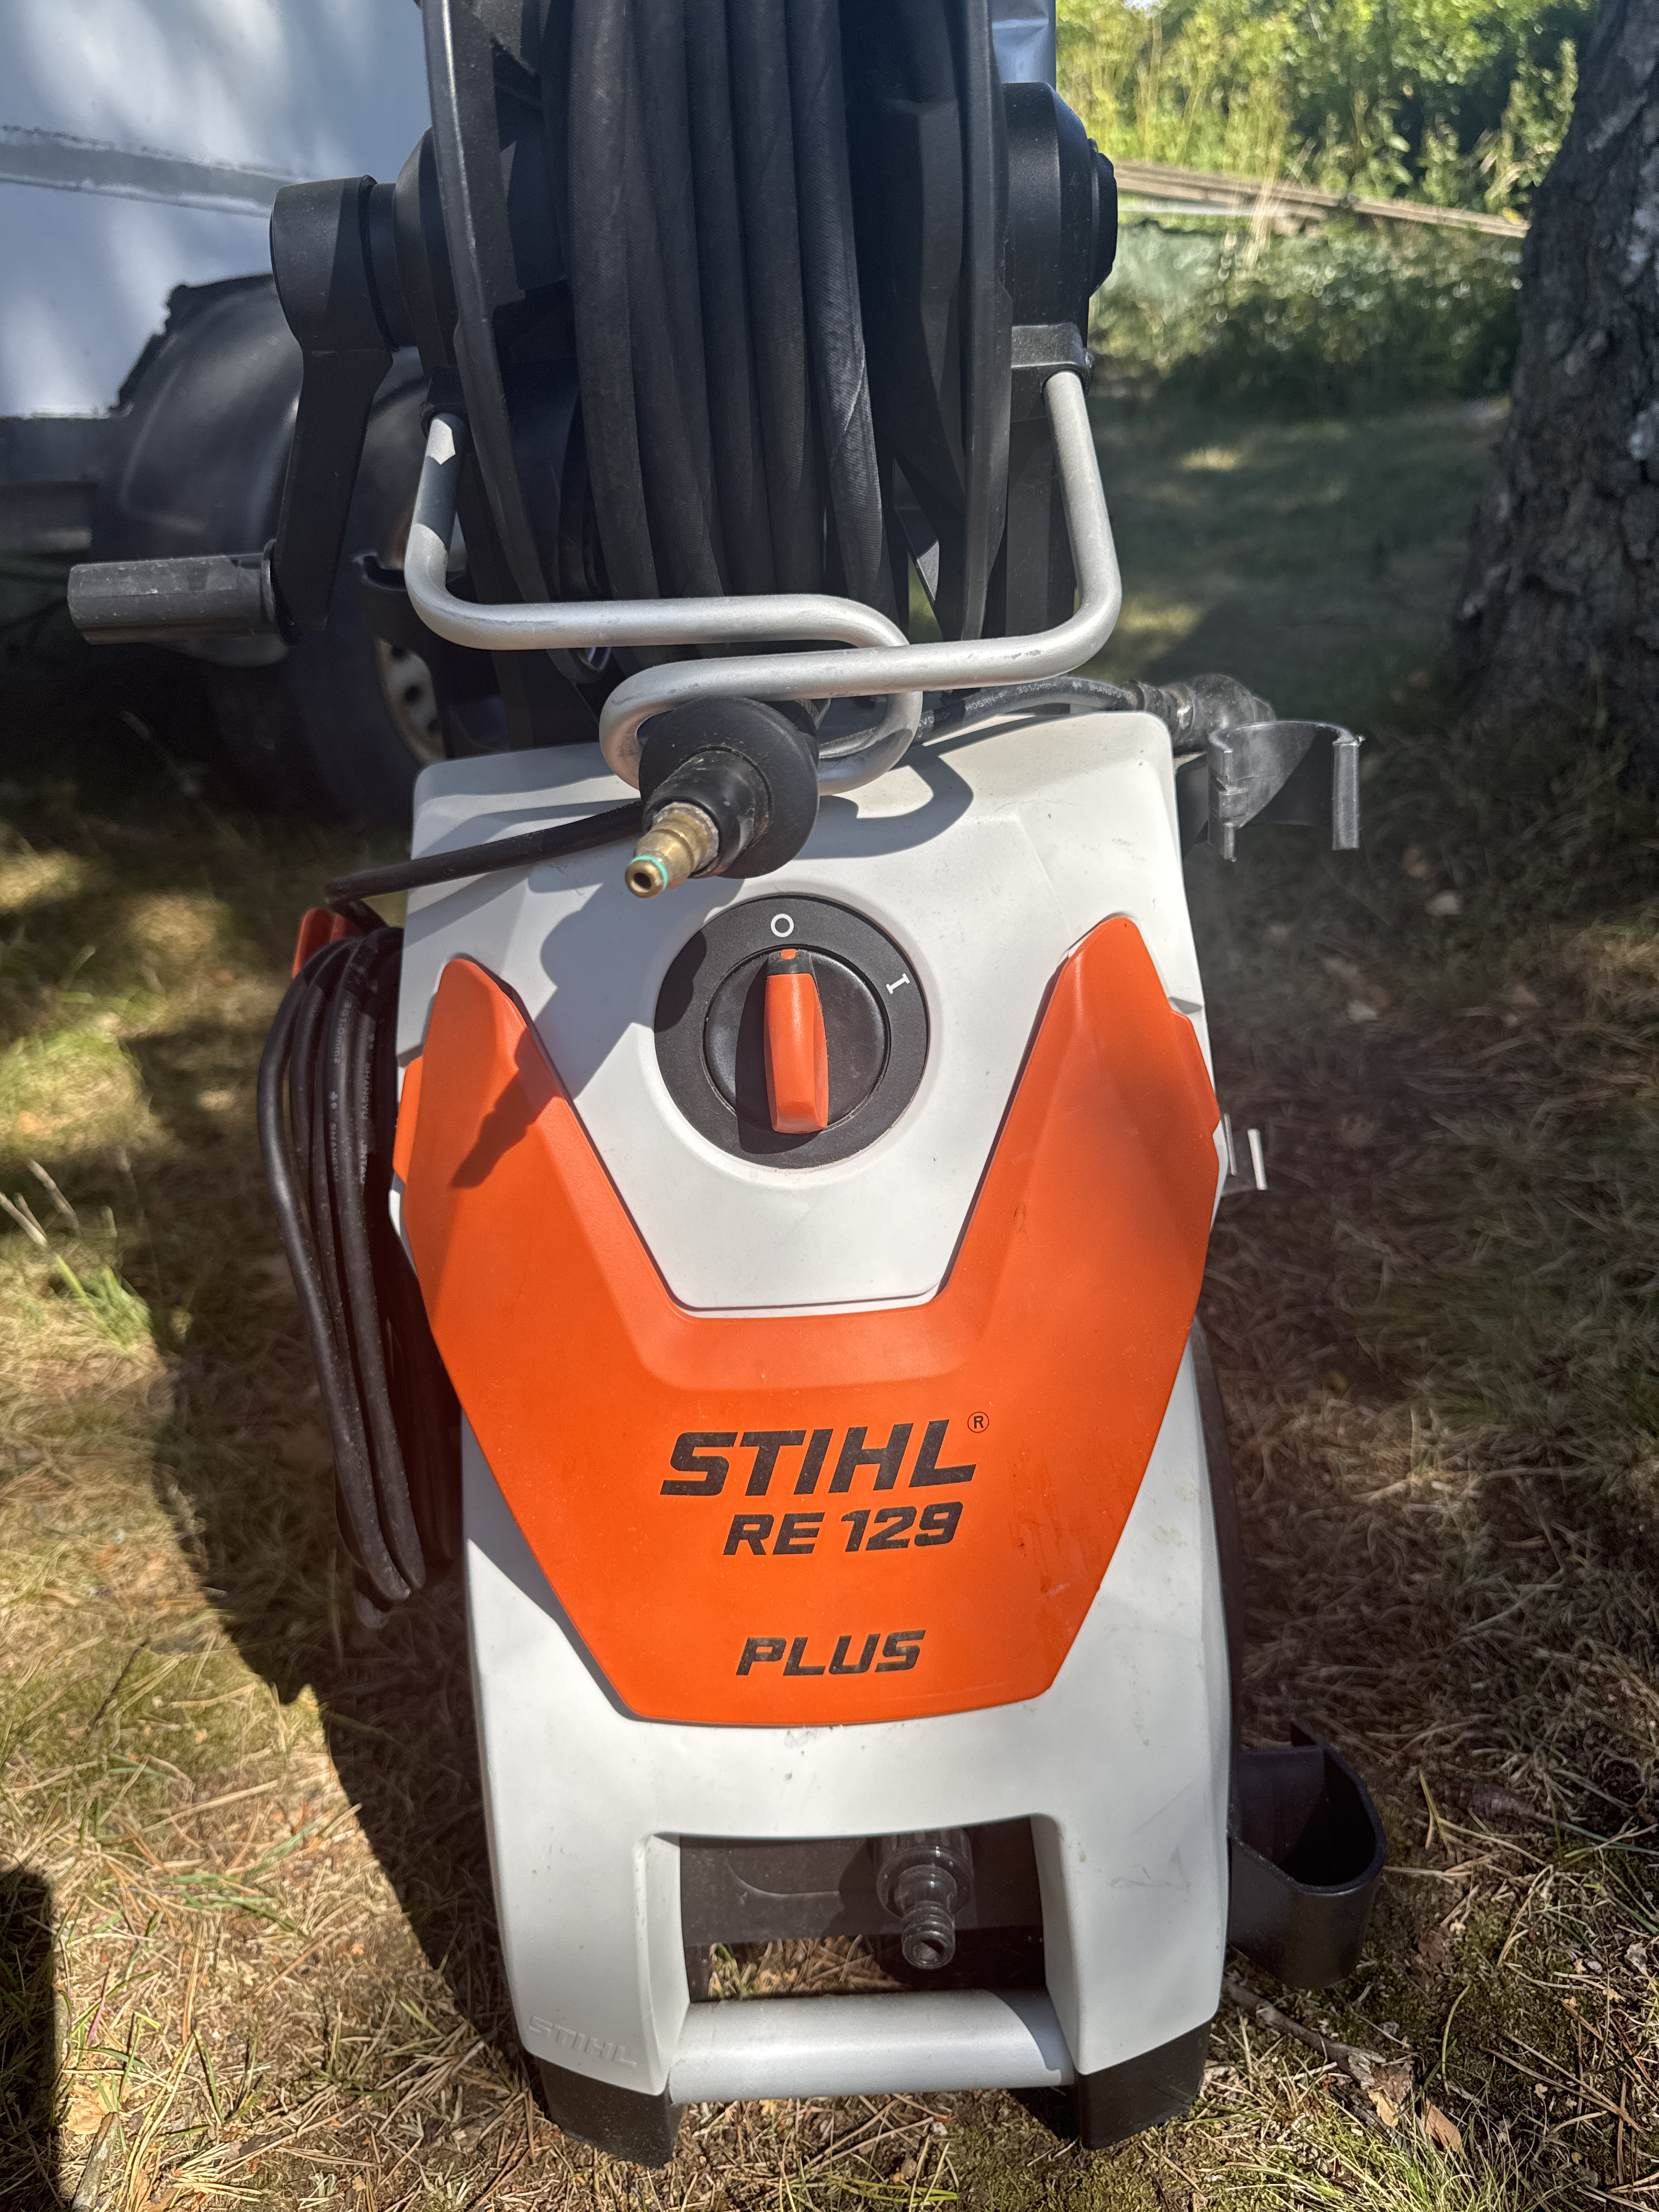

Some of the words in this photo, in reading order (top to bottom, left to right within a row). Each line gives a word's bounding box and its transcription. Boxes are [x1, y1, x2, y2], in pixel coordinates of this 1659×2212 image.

[660, 1419, 977, 1496] STIHL
[723, 1511, 825, 1555] RE
[841, 1501, 963, 1551] 129
[736, 1629, 926, 1675] PLUS
[528, 2015, 637, 2068] STIHL
